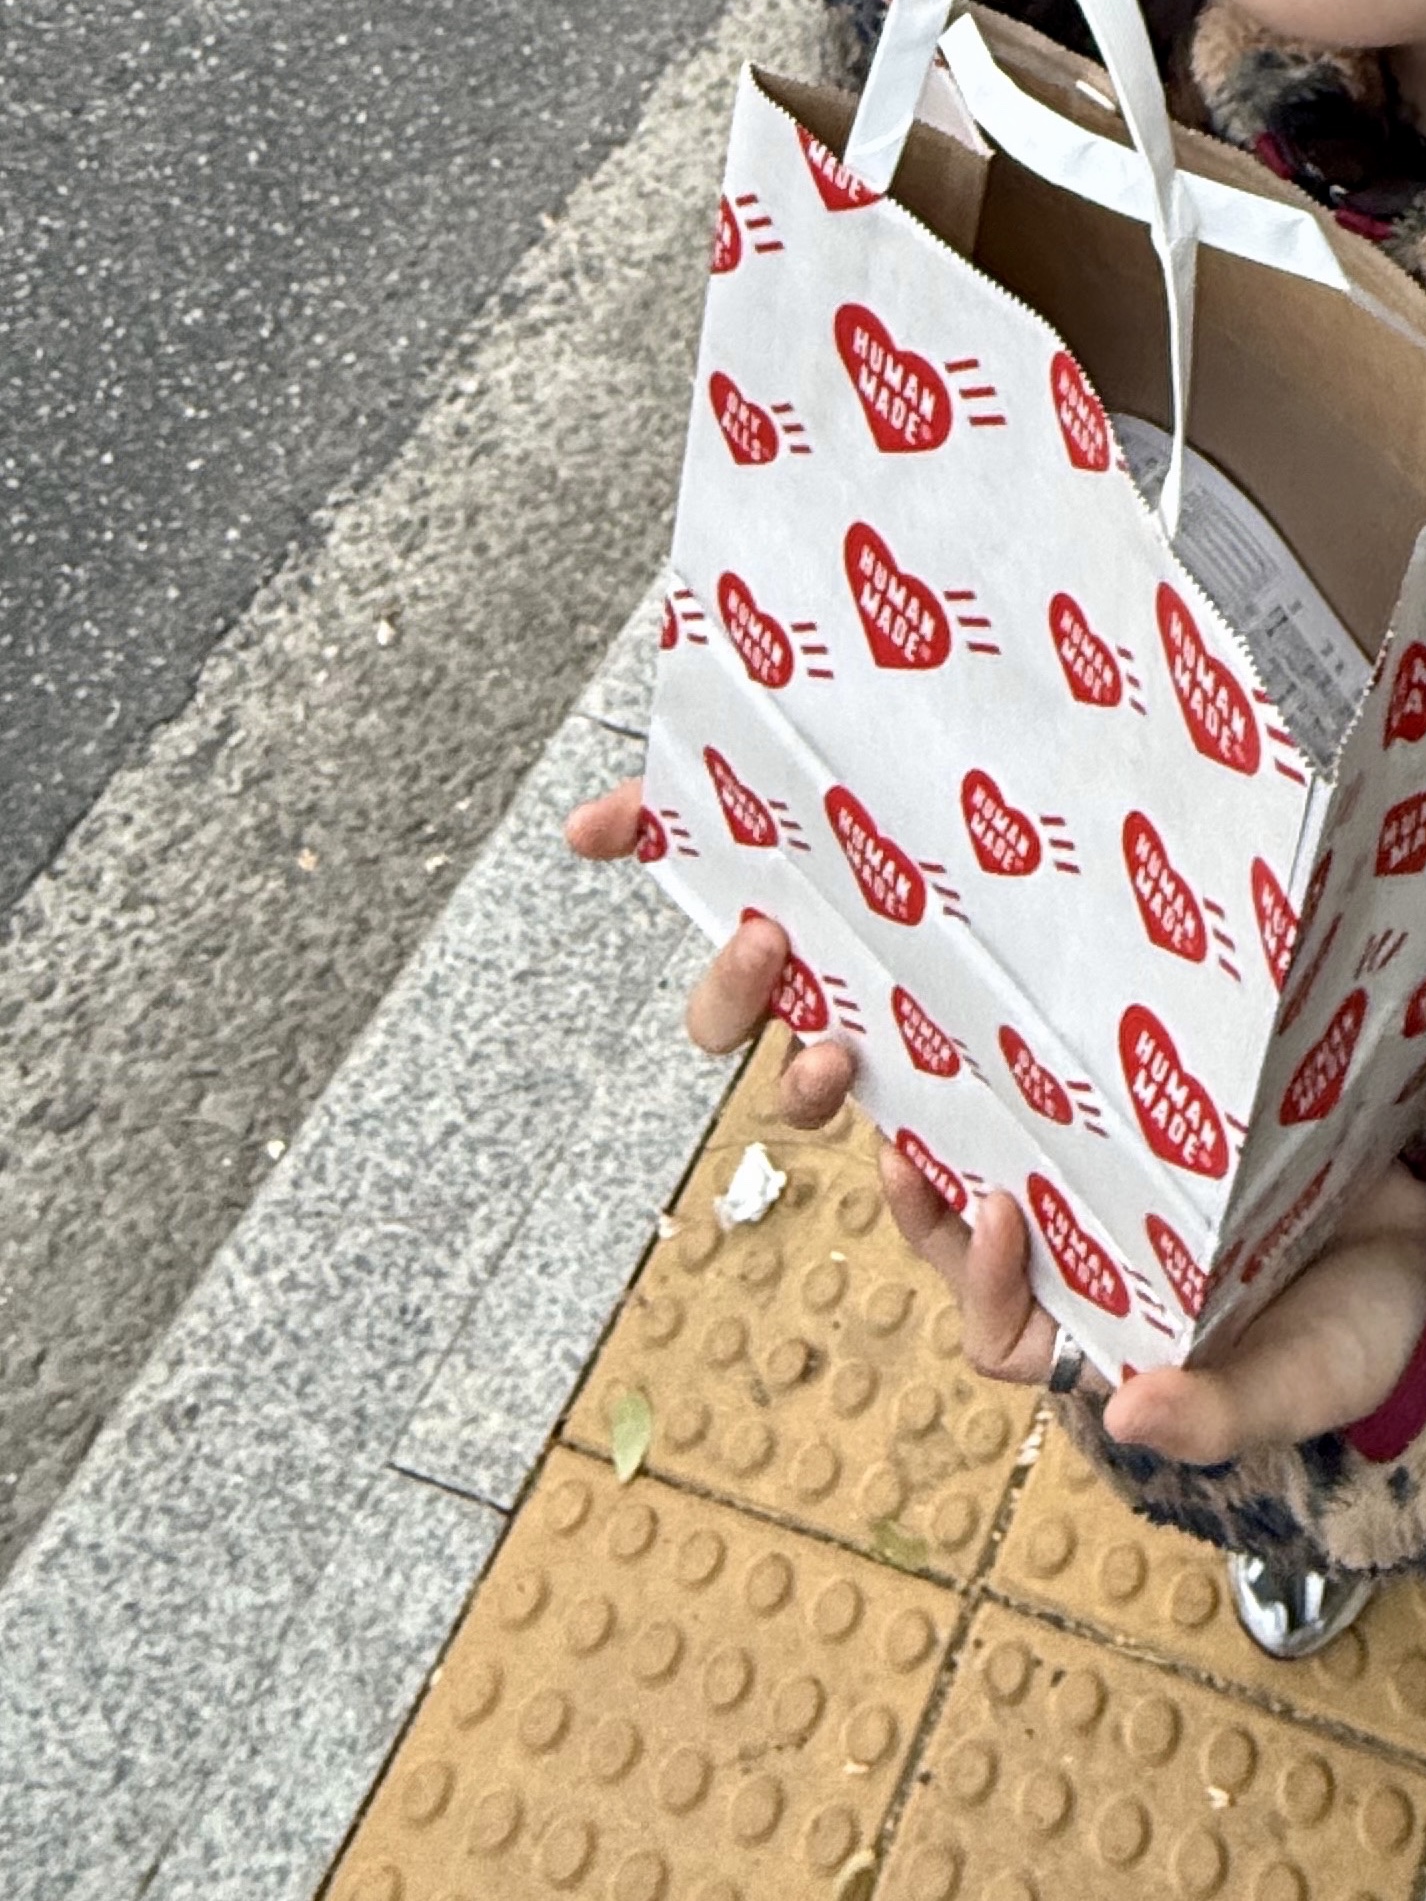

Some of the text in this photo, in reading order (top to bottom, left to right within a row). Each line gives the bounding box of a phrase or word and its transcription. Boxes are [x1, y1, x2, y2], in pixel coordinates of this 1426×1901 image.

[853, 325, 935, 423] HUMAN
[858, 362, 921, 445] MADE
[727, 588, 784, 668] HUMAN
[858, 544, 936, 643] HUMAN
[859, 580, 921, 663] MADE
[730, 617, 772, 680] MADE
[1060, 610, 1115, 688] HUMAN
[1061, 637, 1102, 699] MADE
[1170, 611, 1246, 743] HUMAN
[1174, 654, 1232, 759] MADE
[838, 806, 912, 902] HUMAN
[970, 811, 1016, 871] MADE
[972, 783, 1030, 858] HUMAN
[846, 841, 897, 915] MADE
[1135, 832, 1196, 939] HUMAN
[1136, 866, 1184, 949] MADE
[901, 997, 951, 1061] HUMAN
[1133, 1068, 1200, 1165] MADE
[1135, 1030, 1217, 1152] HUMAN
[1041, 1193, 1116, 1294] HUMAN
[1046, 1221, 1101, 1297] MADE
